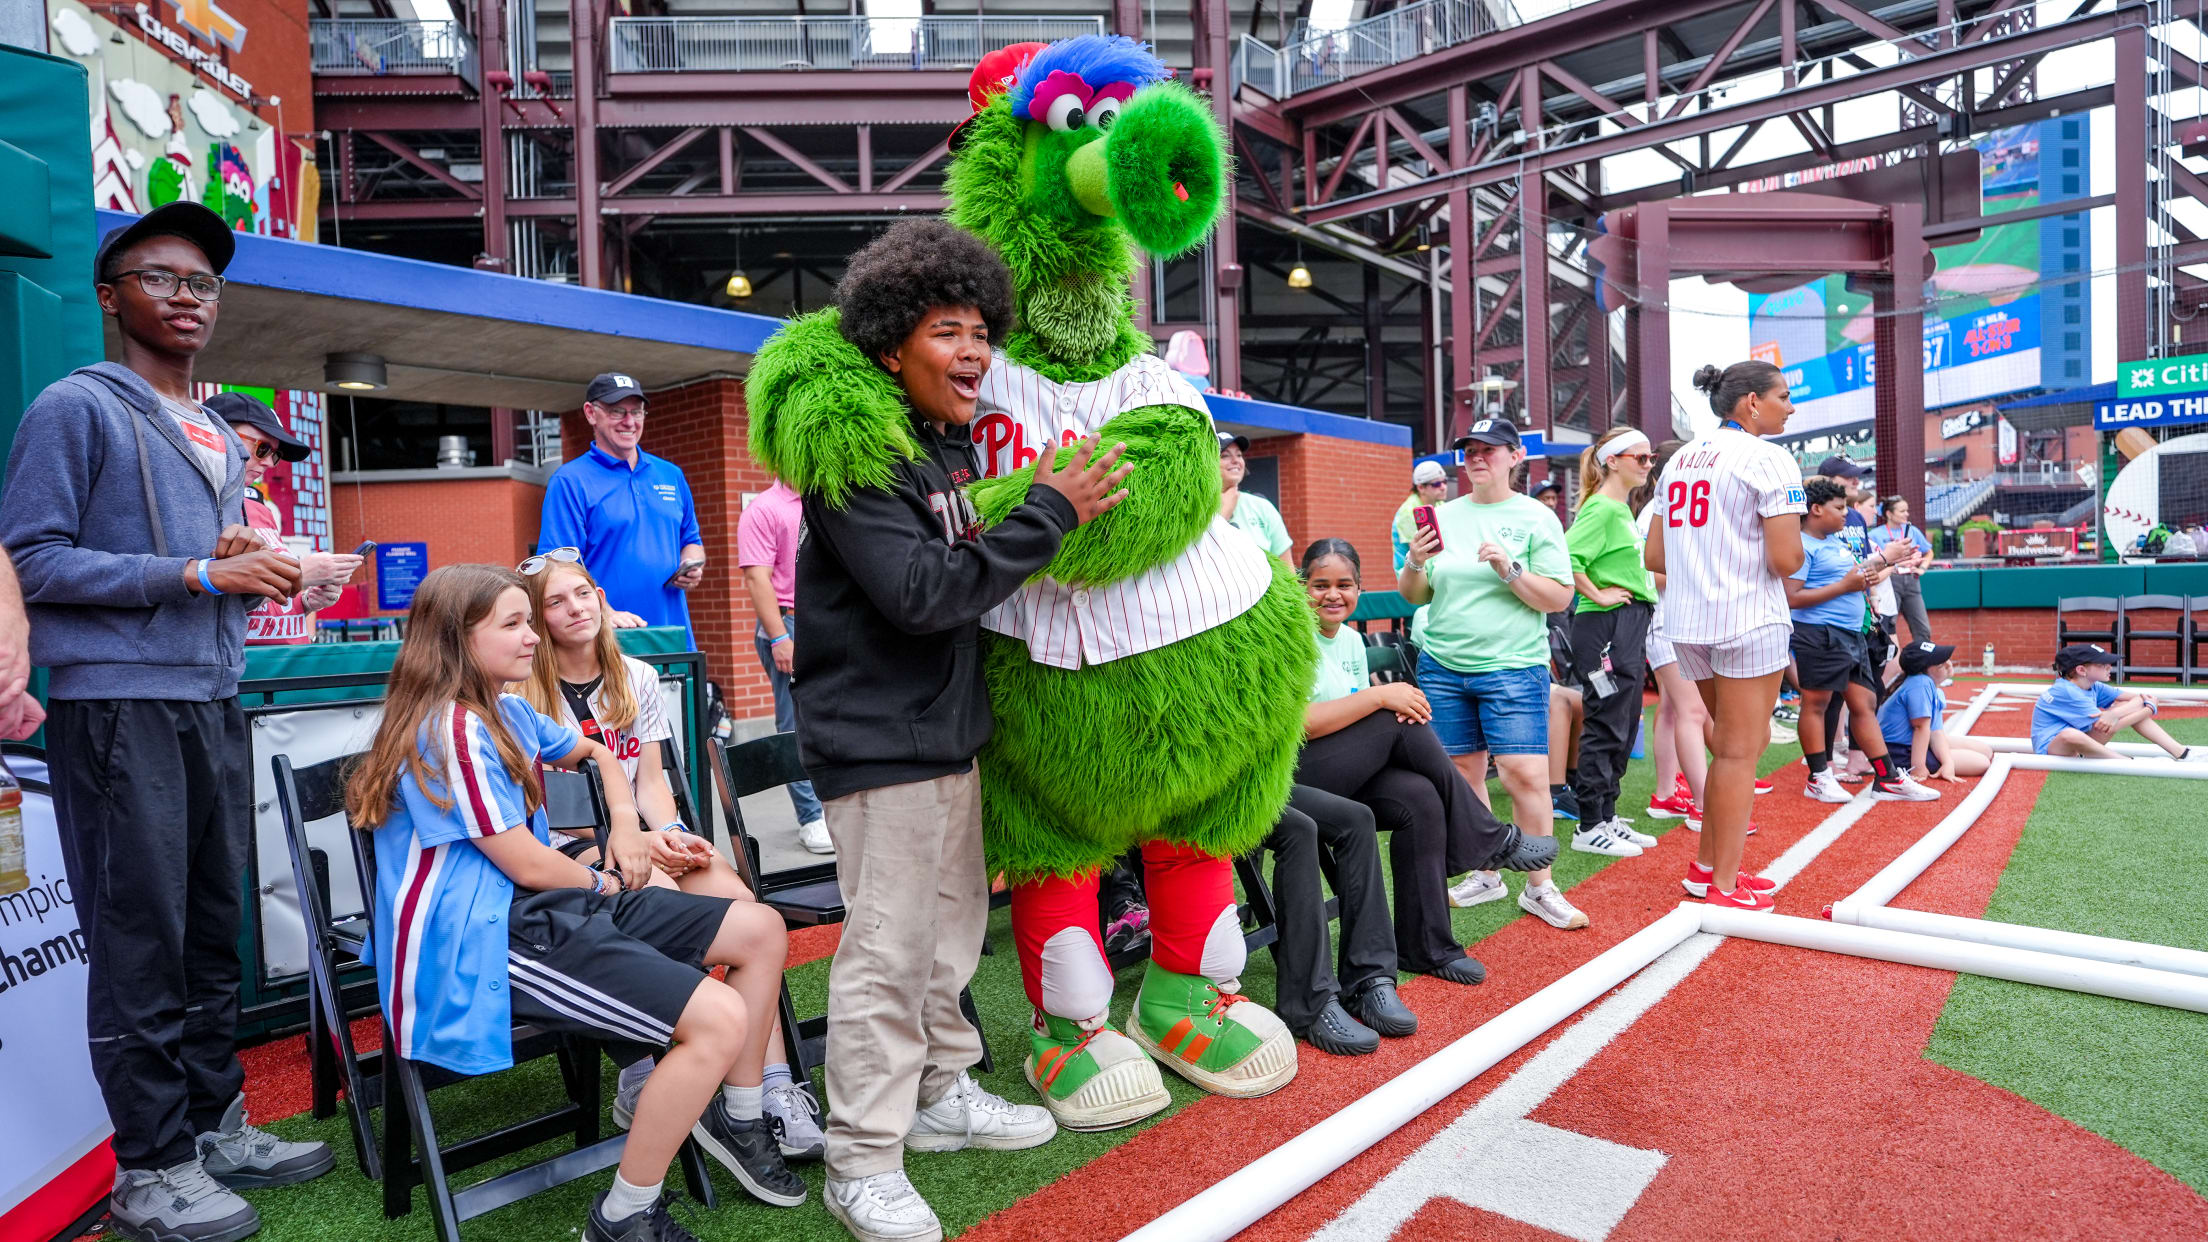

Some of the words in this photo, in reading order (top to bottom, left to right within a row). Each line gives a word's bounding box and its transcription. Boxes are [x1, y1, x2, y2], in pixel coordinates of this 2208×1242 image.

[139, 13, 253, 100] CHEVROLET
[2161, 363, 2208, 385] Citi
[2101, 402, 2163, 423] LEAD
[1676, 451, 1720, 471] NADIA
[1668, 480, 1711, 528] 26
[2008, 544, 2066, 556] Budweiser
[0, 928, 88, 993] hamp
